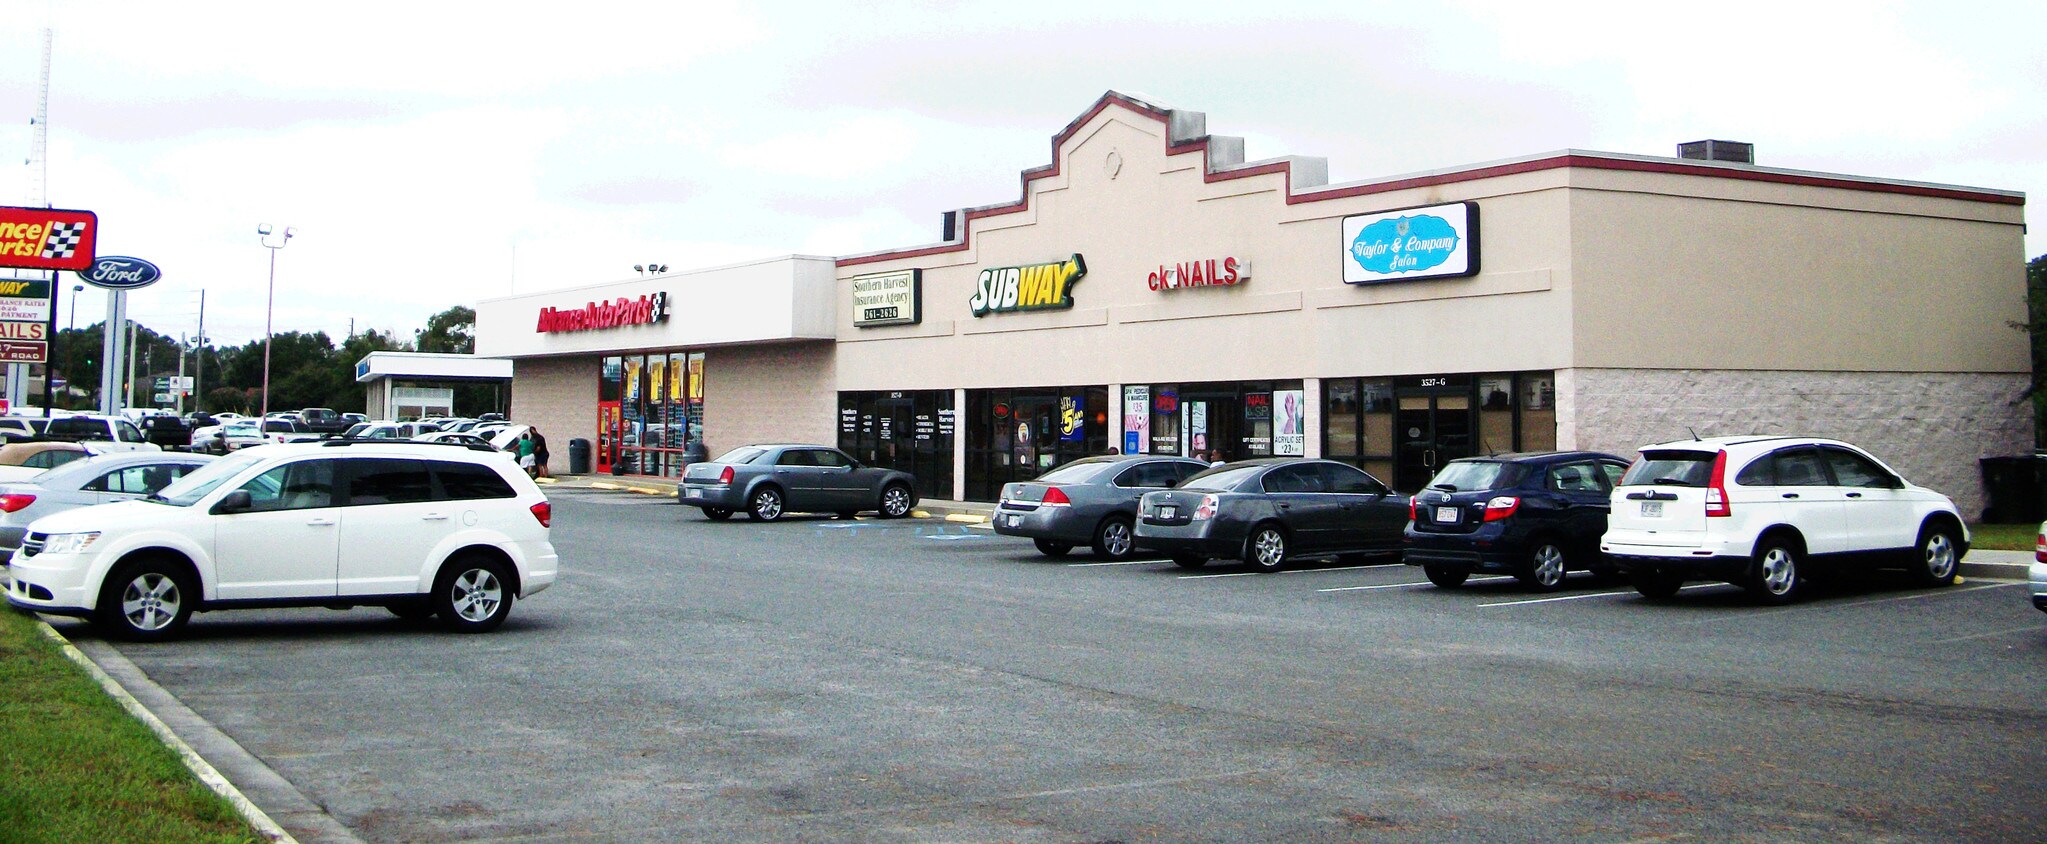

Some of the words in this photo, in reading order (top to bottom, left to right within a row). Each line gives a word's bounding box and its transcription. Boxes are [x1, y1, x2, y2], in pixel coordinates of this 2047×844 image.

[1355, 239, 1388, 259] Taylor
[1391, 237, 1402, 253] &
[1405, 236, 1454, 253] Company
[1390, 254, 1417, 270] Salon
[93, 261, 143, 281] Ford
[1177, 257, 1237, 287] NAILS
[854, 279, 881, 292] Southern
[884, 277, 908, 289] Harvest
[970, 258, 1077, 310] SUBWAY
[854, 294, 883, 305] Insurance
[885, 292, 908, 305] Agency
[536, 306, 585, 333] Advance
[585, 300, 614, 330] Auto
[614, 295, 650, 327] Parts
[865, 308, 897, 319] 261-2626
[1421, 378, 1446, 387] 3527-G
[1275, 436, 1293, 444] ACRYLIC
